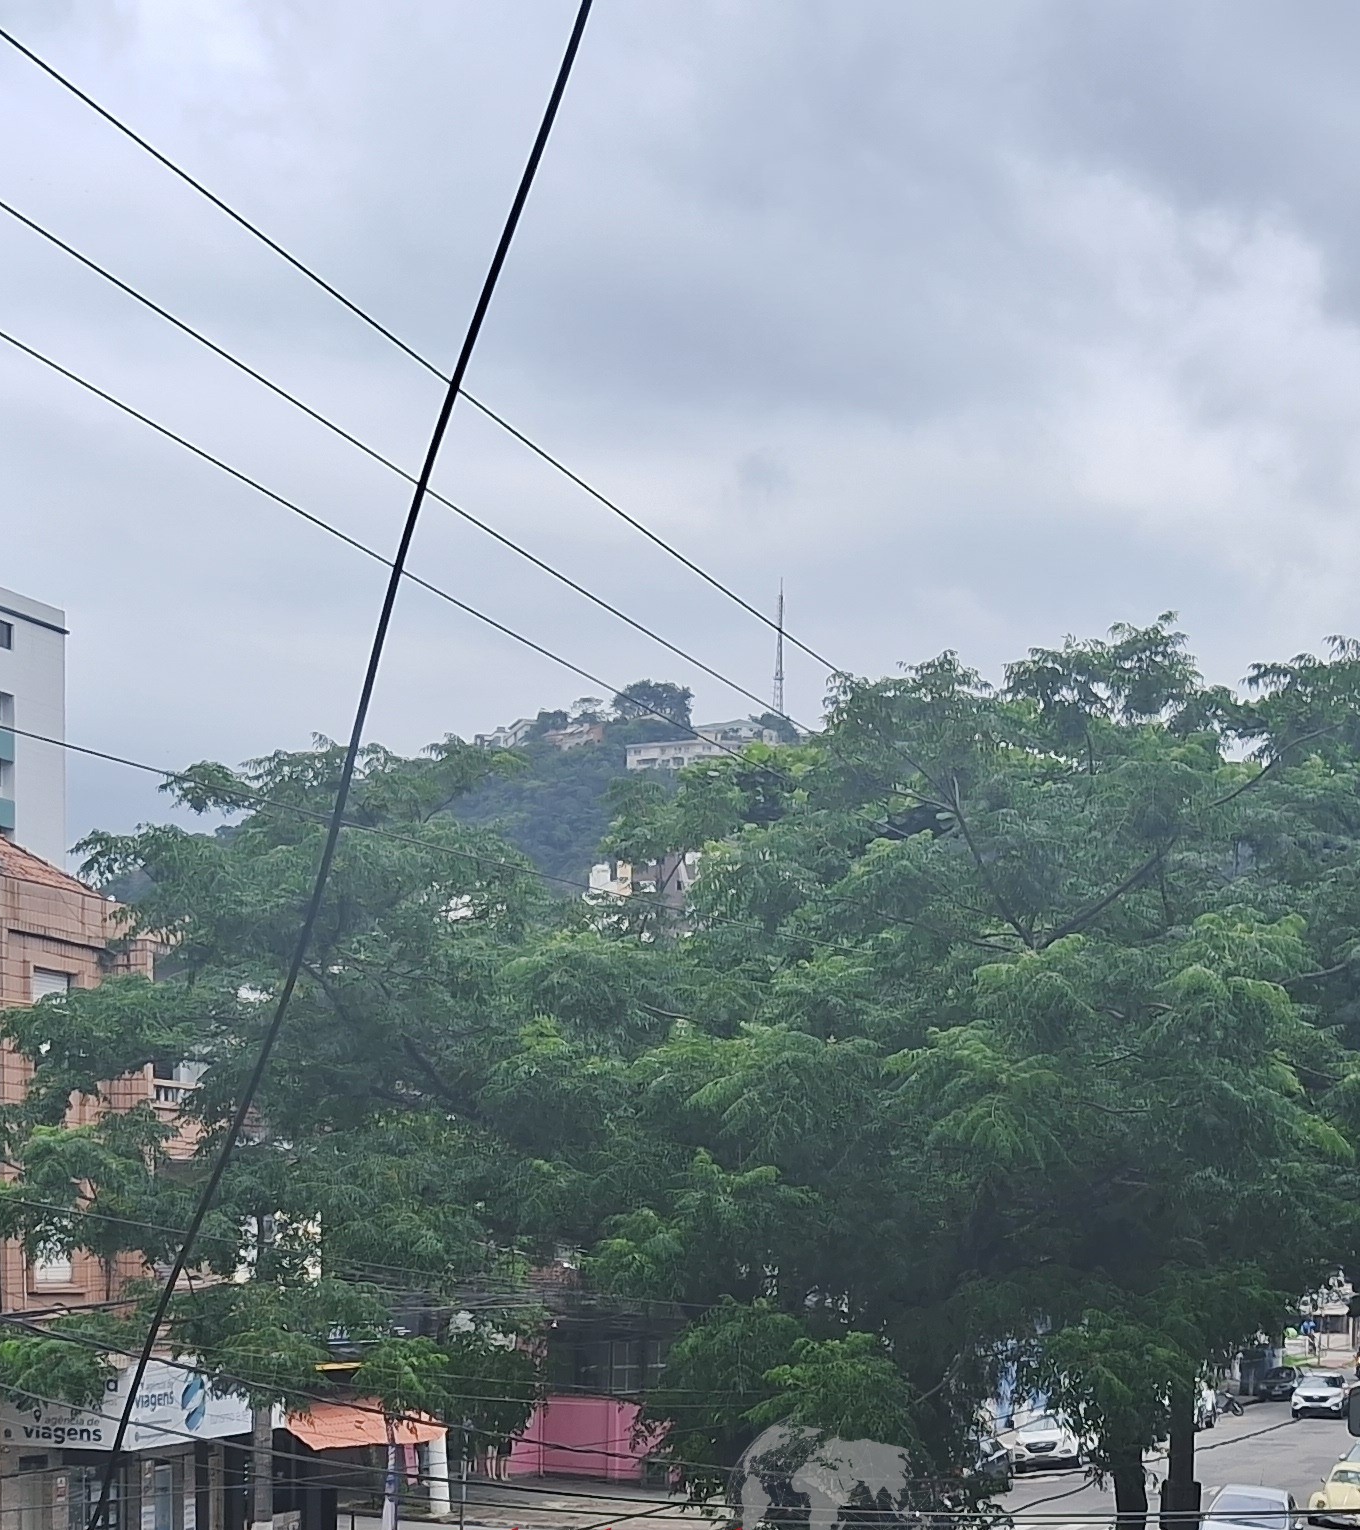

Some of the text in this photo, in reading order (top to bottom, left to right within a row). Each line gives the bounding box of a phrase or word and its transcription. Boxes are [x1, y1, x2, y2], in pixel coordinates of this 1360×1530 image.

[135, 1391, 174, 1412] viagens
[87, 1416, 100, 1427] de
[22, 1425, 102, 1445] viagens
